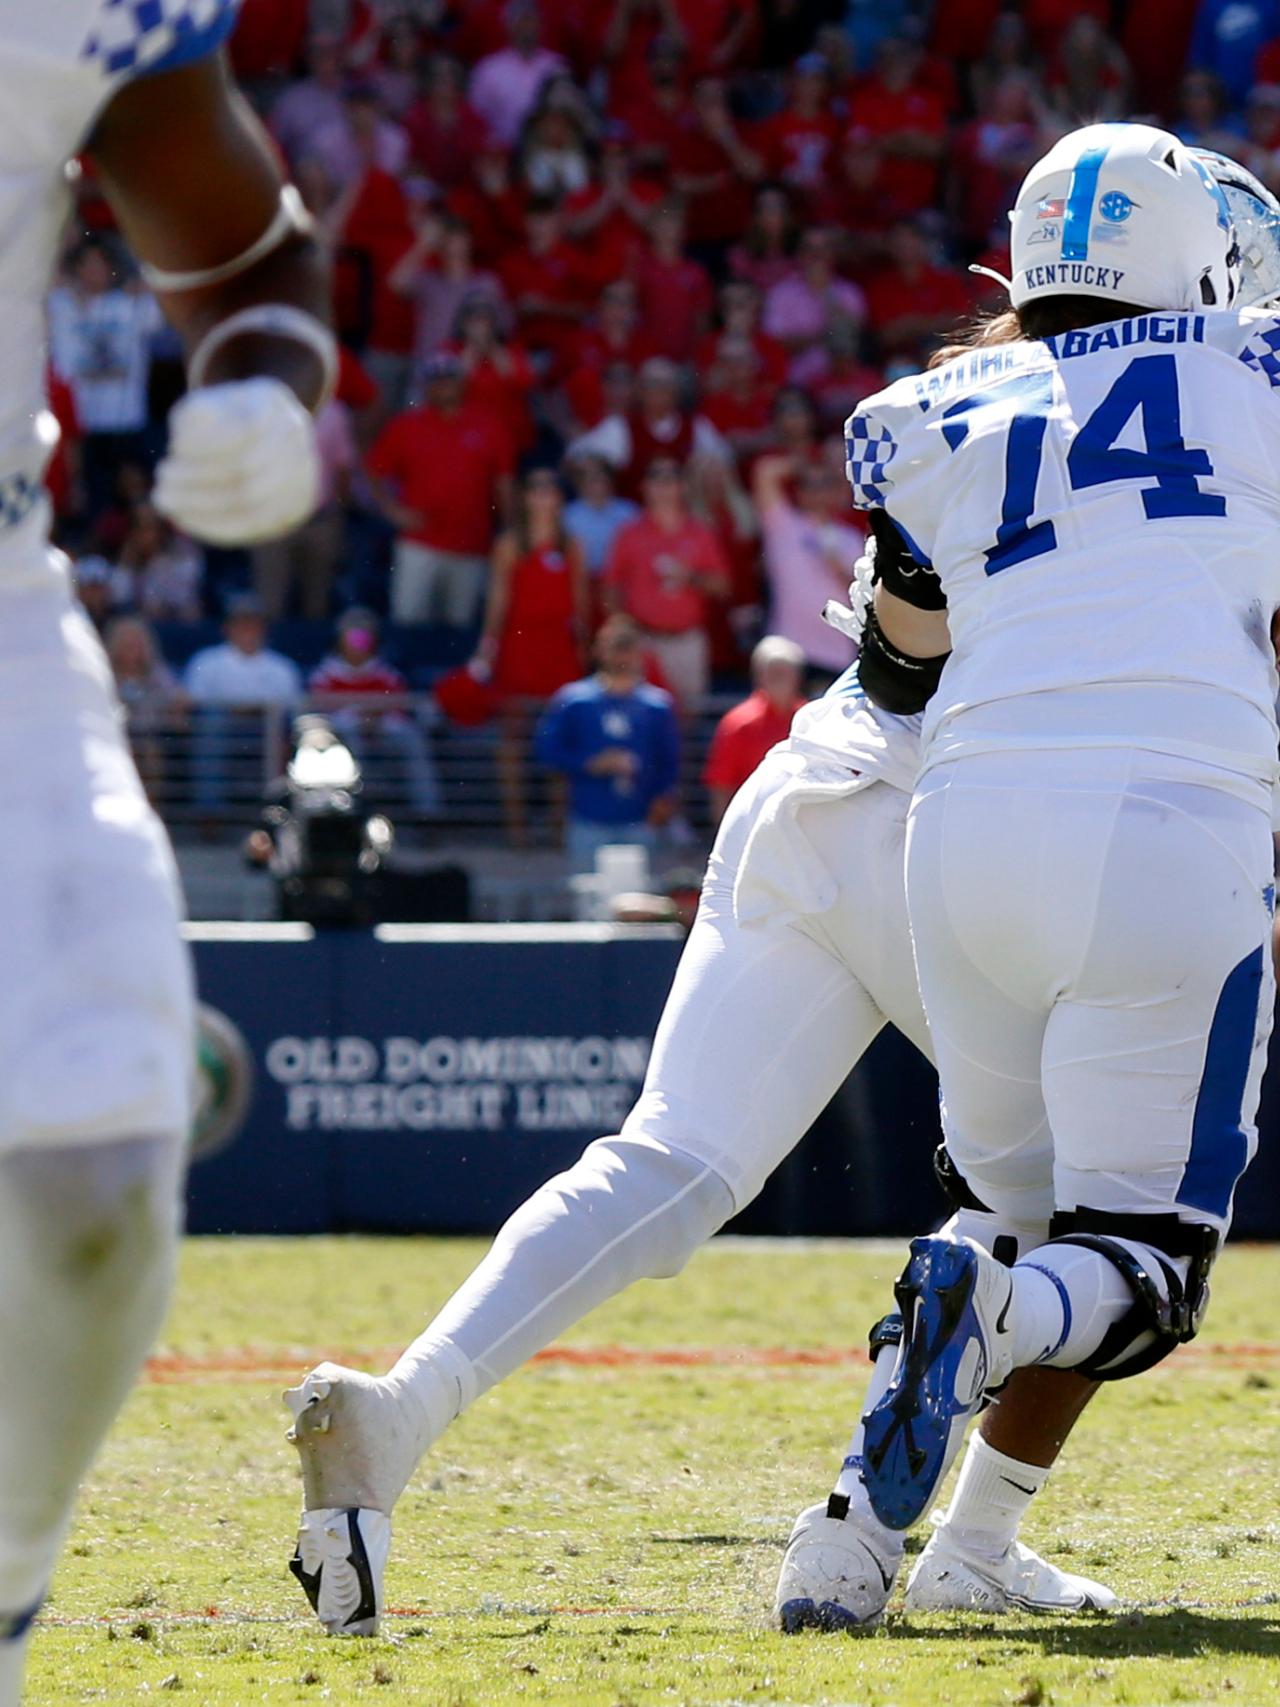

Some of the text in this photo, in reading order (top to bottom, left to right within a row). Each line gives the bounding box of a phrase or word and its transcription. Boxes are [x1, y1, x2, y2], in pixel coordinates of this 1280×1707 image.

[1024, 263, 1125, 291] KENTUCKY
[942, 354, 1227, 578] 74
[266, 1036, 651, 1083] OLD DOMINION
[286, 1083, 503, 1130] FREIGHT
